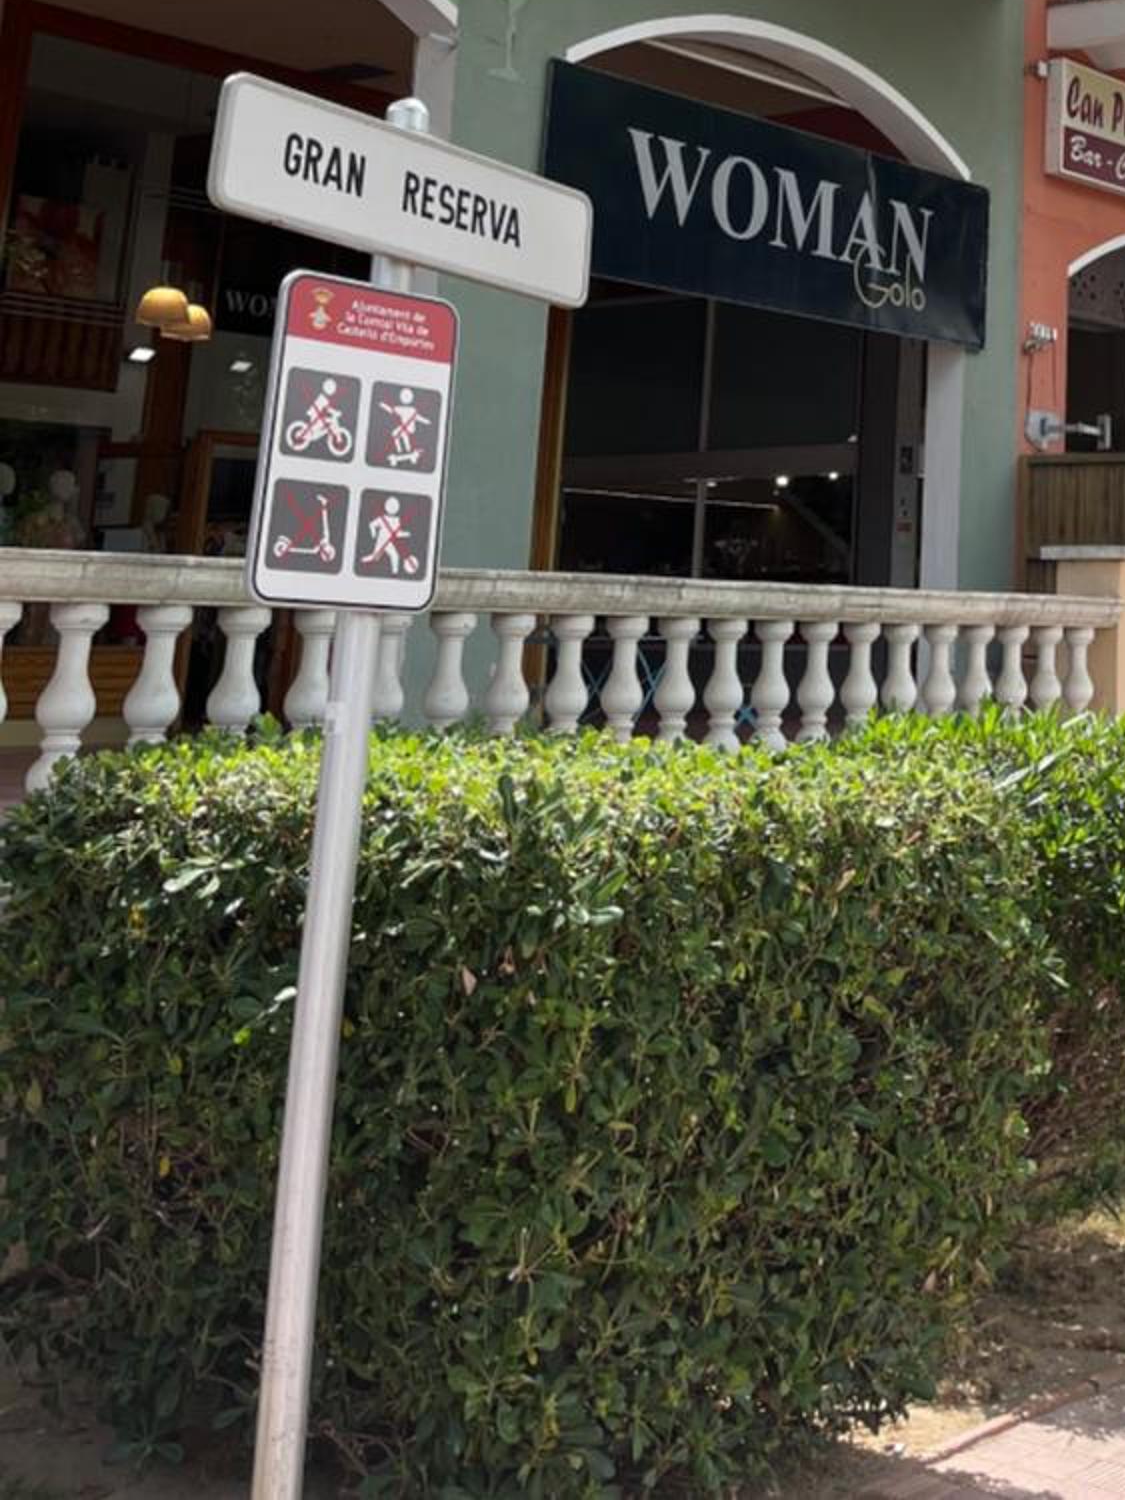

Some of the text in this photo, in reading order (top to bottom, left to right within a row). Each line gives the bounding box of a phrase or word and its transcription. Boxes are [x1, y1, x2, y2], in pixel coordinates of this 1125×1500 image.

[1066, 76, 1104, 129] Can
[1069, 135, 1102, 167] Bar
[284, 133, 521, 249] GRAN RESERVA
[627, 127, 934, 284] WOMAN
[345, 311, 356, 323] la
[416, 323, 430, 337] de
[352, 300, 427, 323] Ajuntament de
